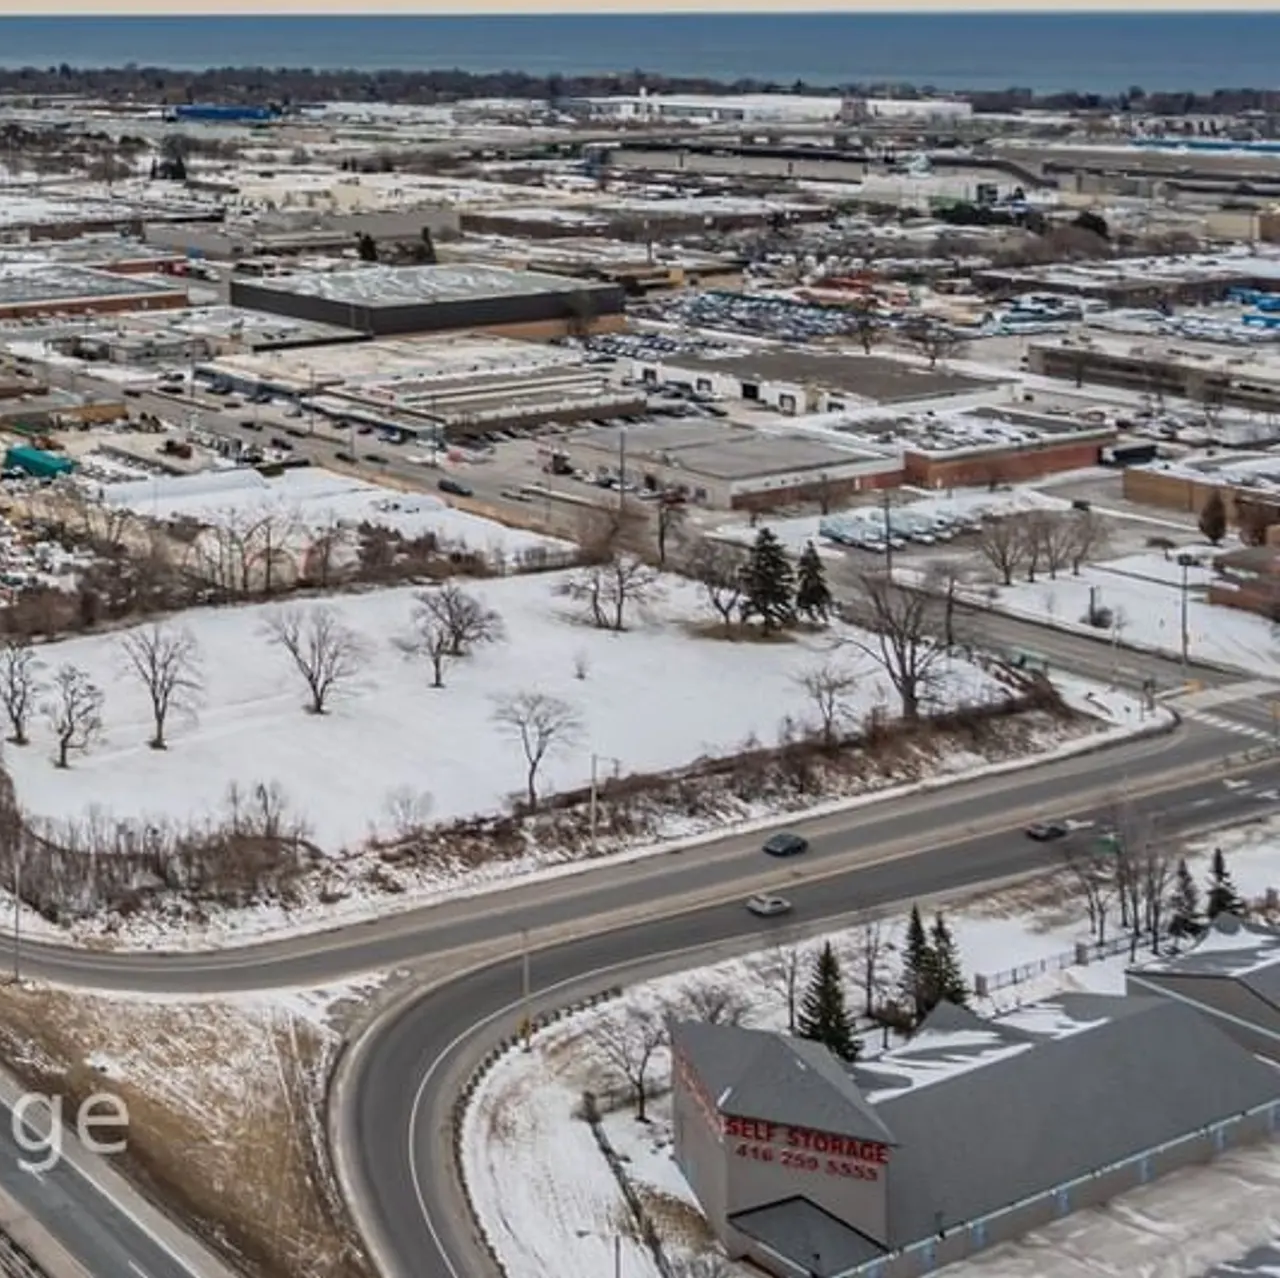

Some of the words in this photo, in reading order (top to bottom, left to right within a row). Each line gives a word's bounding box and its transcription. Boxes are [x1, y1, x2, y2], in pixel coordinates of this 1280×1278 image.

[725, 1118, 775, 1142] SELF
[787, 1129, 889, 1164] STORAGE
[735, 1144, 773, 1162] 416
